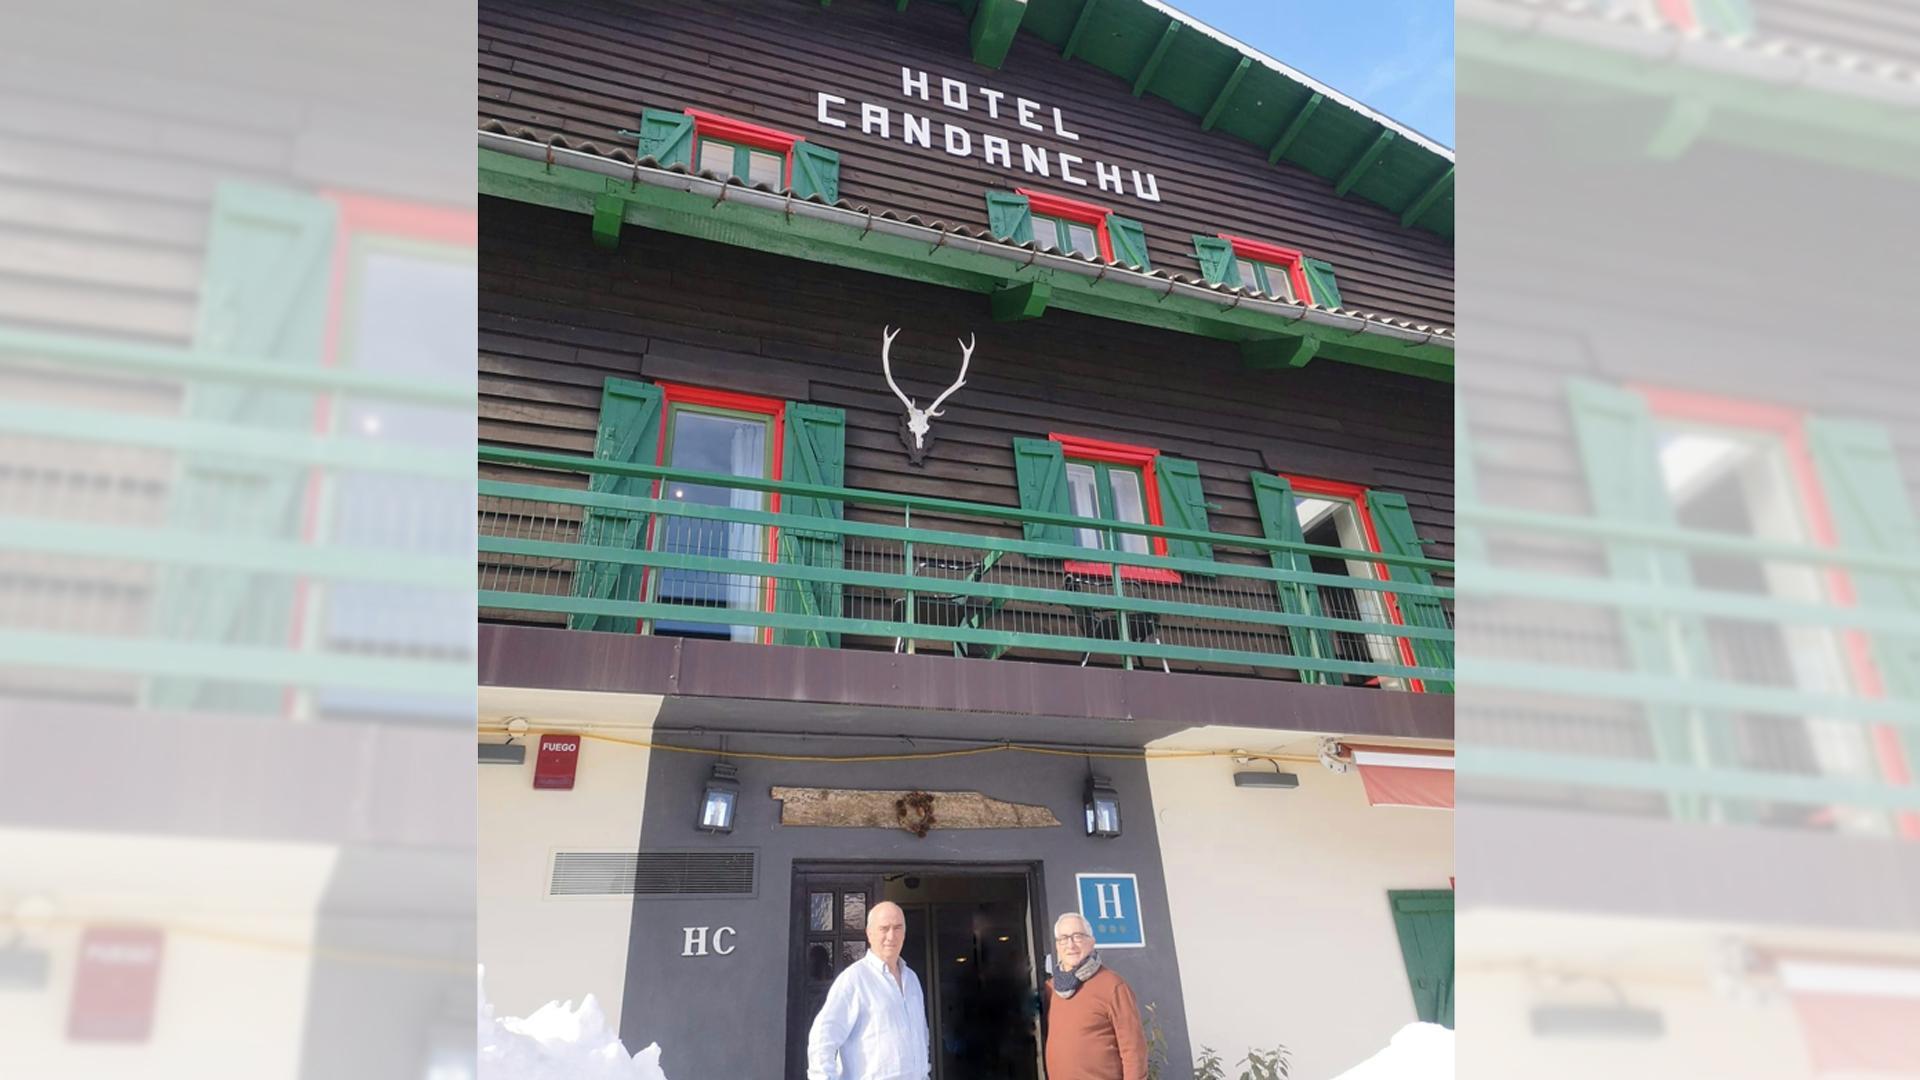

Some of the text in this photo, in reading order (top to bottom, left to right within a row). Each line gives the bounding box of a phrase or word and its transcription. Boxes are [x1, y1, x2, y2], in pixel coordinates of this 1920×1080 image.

[902, 66, 1079, 141] HOTEL
[818, 92, 1161, 202] CANDANCHU
[543, 743, 577, 752] FUEGO
[1095, 883, 1125, 919] H
[681, 927, 736, 956] HC
